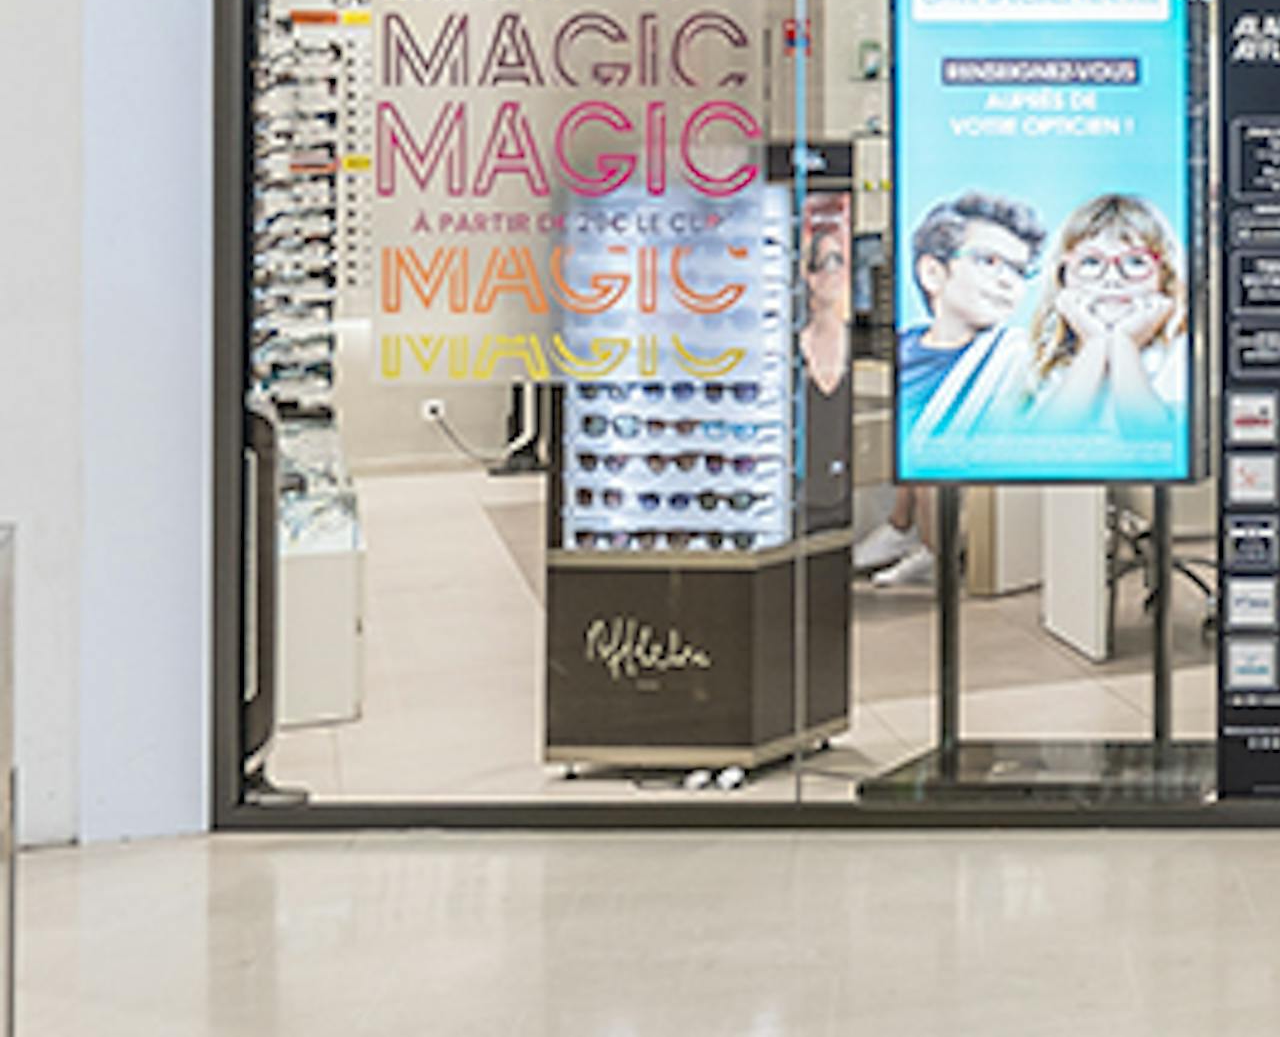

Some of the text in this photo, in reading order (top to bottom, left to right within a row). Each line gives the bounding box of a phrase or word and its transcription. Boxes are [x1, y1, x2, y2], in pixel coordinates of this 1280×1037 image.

[382, 12, 751, 87] MAGIC
[1071, 92, 1096, 110] DE
[1023, 116, 1120, 136] OPTICIEN
[376, 101, 762, 198] MAGIC
[438, 213, 531, 235] PARTIR
[381, 247, 749, 314] MAGIC
